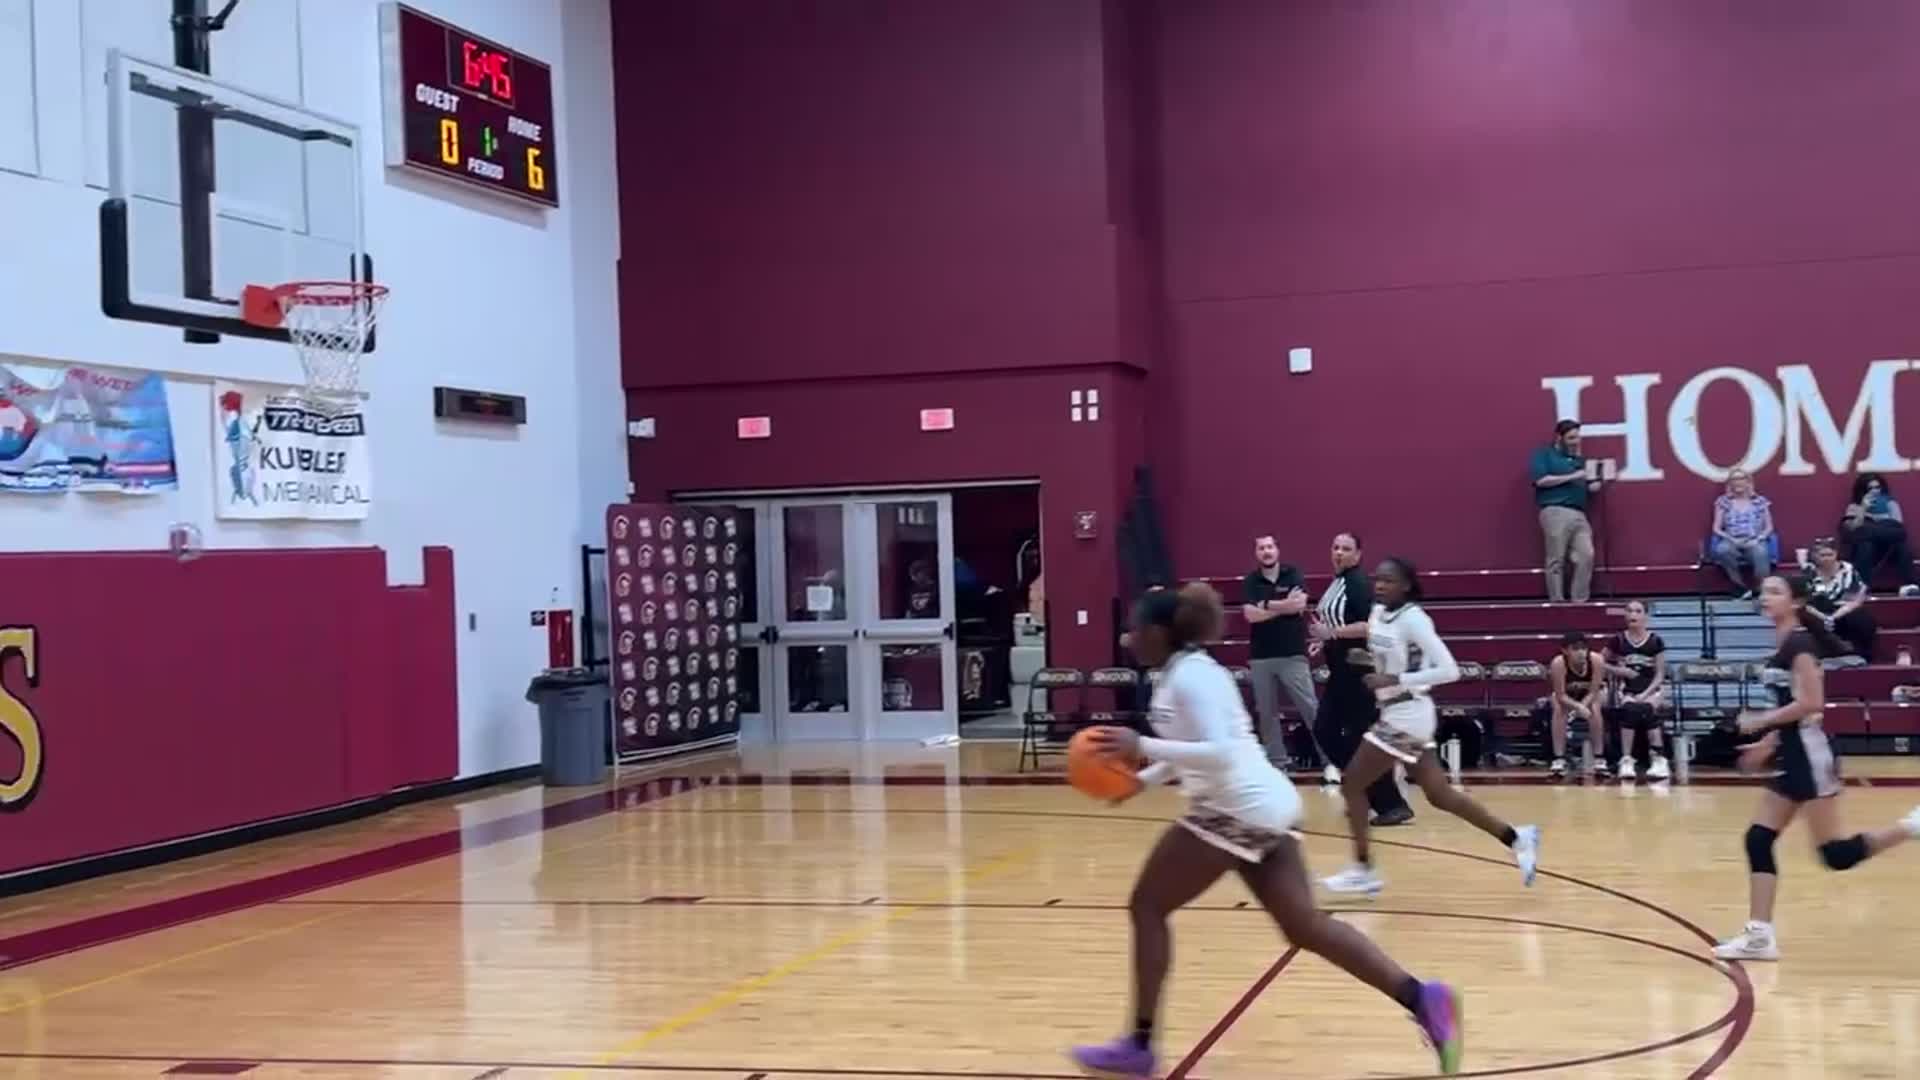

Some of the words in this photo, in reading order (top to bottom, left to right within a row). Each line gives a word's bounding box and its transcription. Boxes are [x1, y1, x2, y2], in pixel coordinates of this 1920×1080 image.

[415, 82, 460, 112] GUEST
[441, 118, 459, 165] 0
[508, 115, 543, 141] HOME
[467, 157, 504, 179] PERIOD
[527, 147, 545, 190] 6
[1541, 359, 1920, 483] HOM
